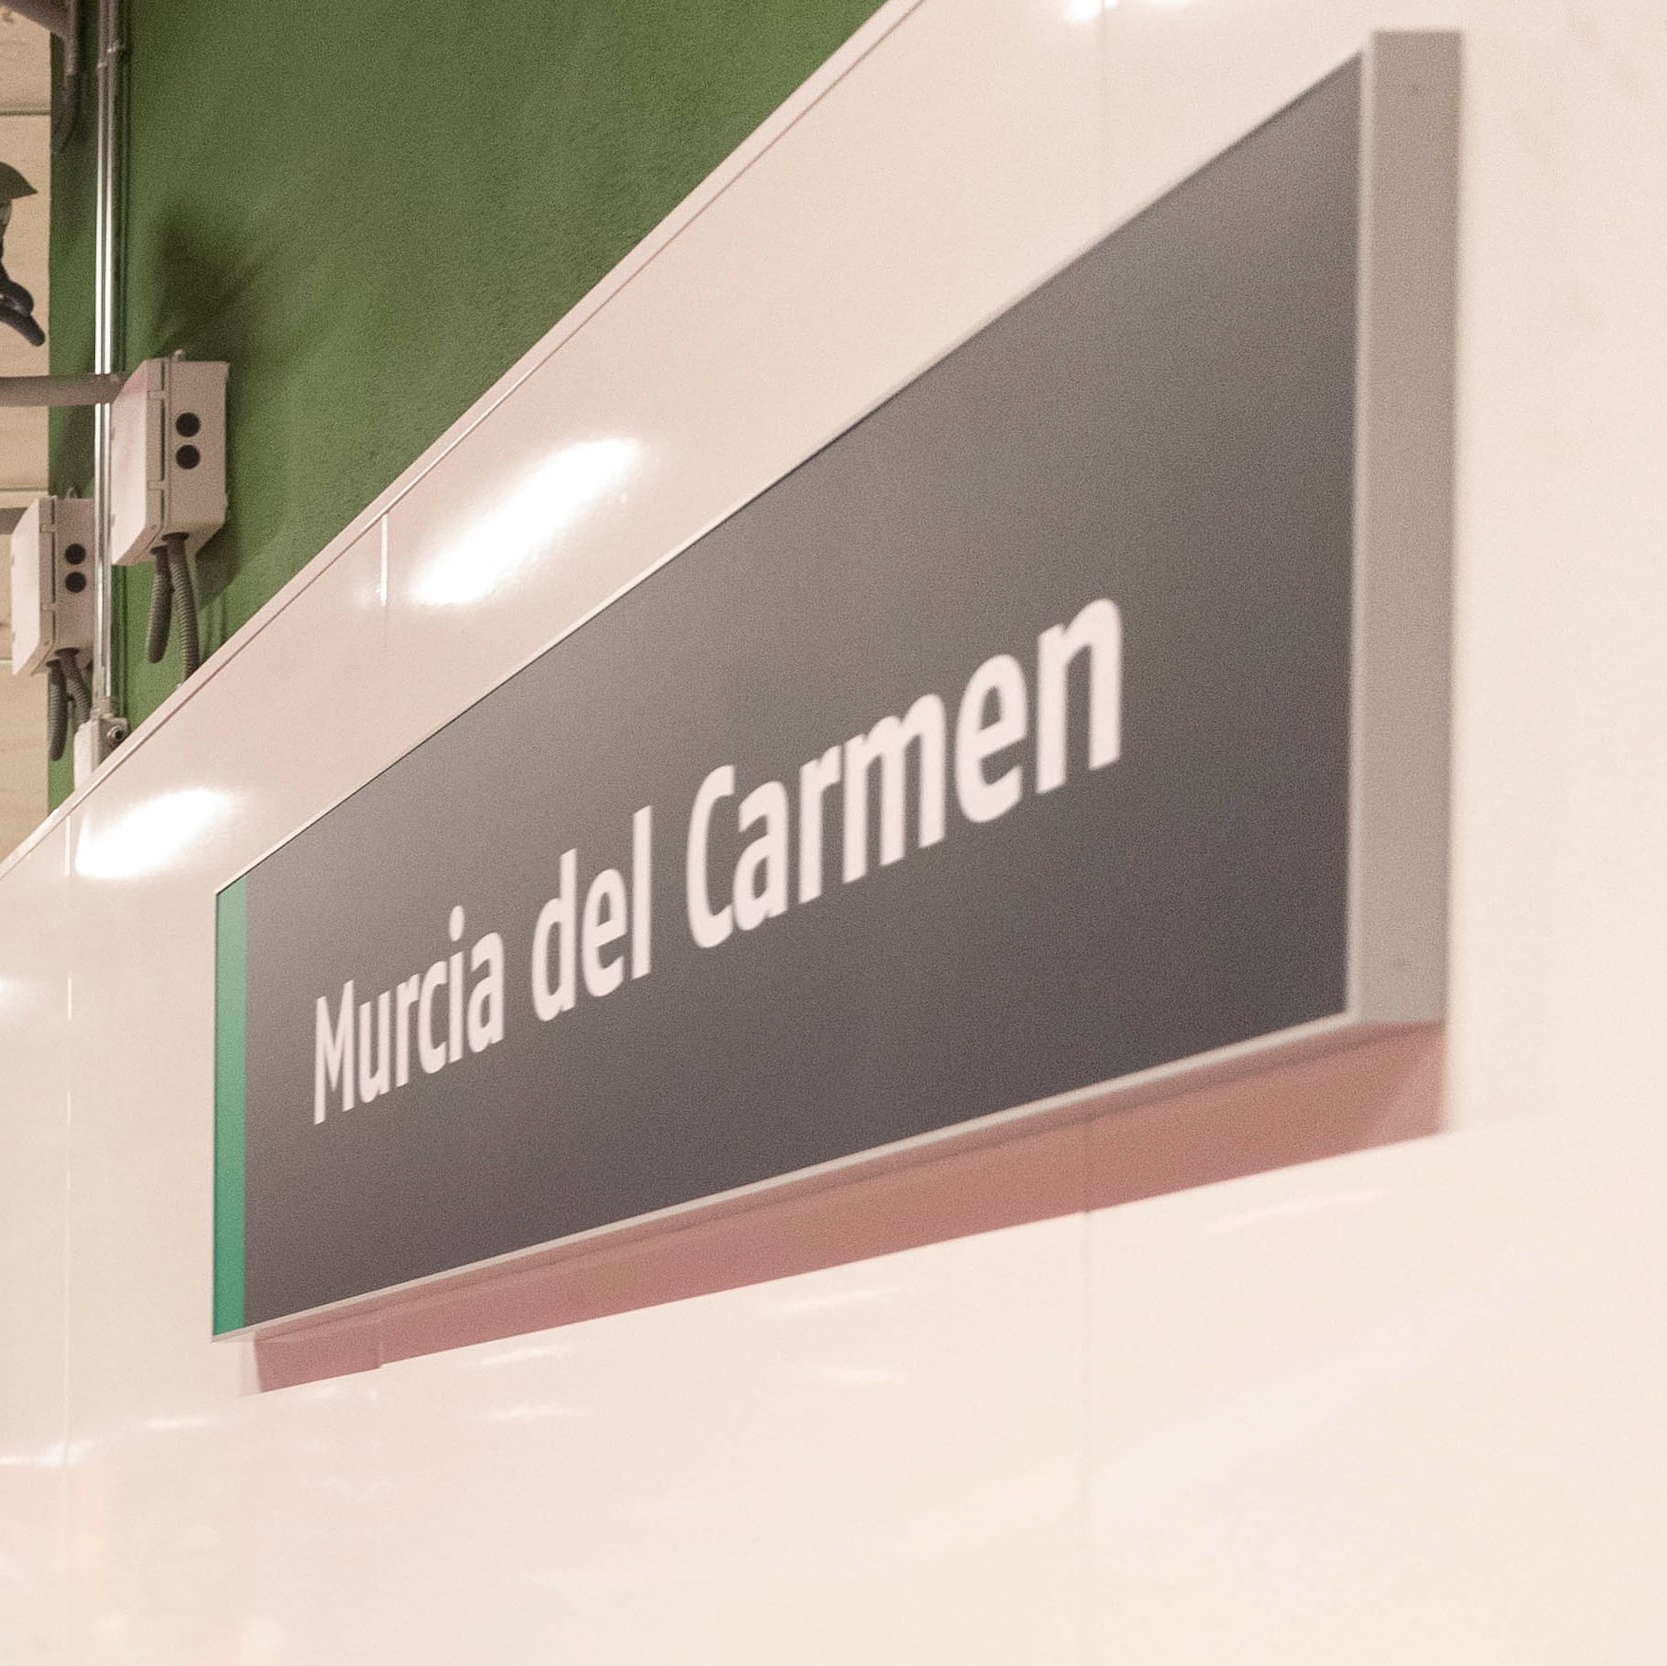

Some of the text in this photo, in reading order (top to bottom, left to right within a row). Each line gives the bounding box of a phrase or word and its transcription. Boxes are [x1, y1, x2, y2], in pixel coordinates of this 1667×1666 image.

[313, 597, 1124, 1126] Murcia del Carmen
